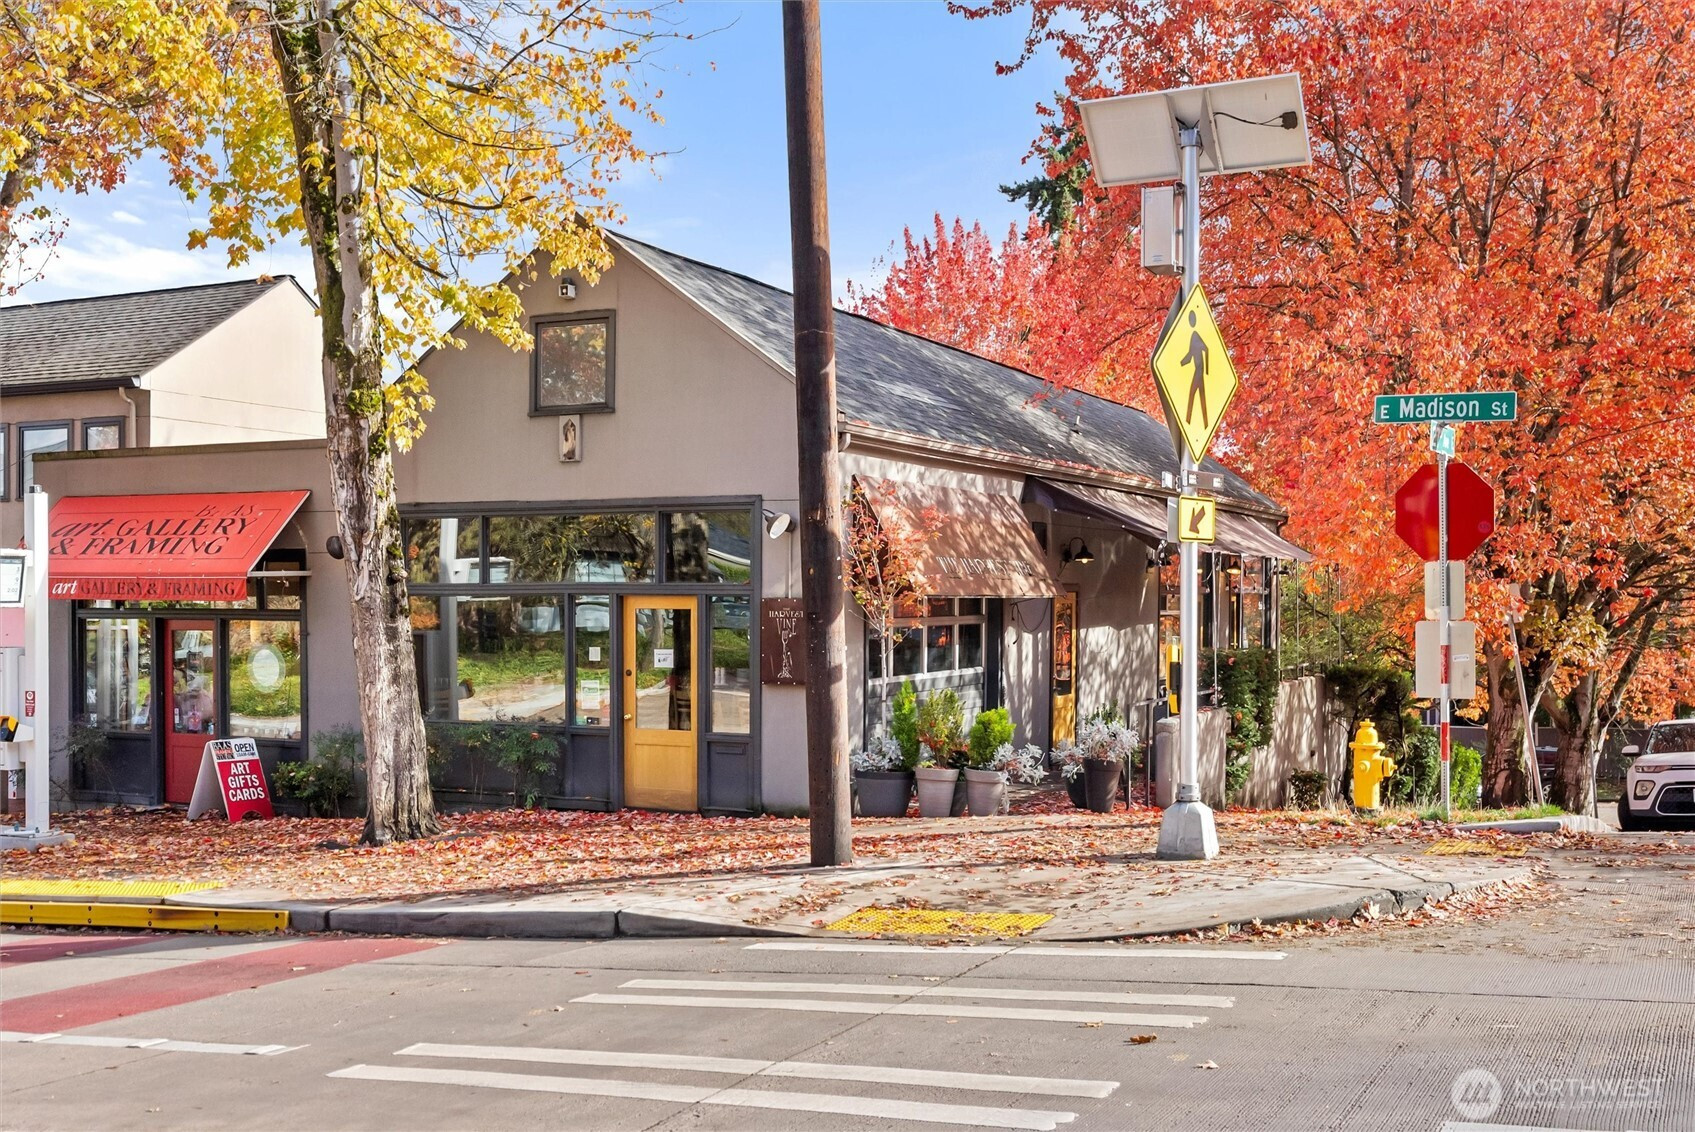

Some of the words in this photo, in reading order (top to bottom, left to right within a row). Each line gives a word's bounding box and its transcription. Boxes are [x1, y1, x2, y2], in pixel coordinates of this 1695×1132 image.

[1380, 405, 1390, 419] E
[1400, 397, 1480, 419] Madison
[1491, 401, 1508, 417] St
[116, 517, 258, 537] GALLERY
[49, 537, 75, 556] &
[78, 537, 229, 556] FRAMING
[52, 580, 78, 595] art
[80, 580, 144, 595] GALLERY
[146, 581, 158, 595] &
[163, 581, 236, 596] FRAMING
[768, 610, 804, 618] HARVEST
[776, 618, 797, 635] VINE
[234, 743, 255, 752] OPEN
[231, 762, 250, 775] ART
[228, 775, 260, 788] GIFTS
[228, 787, 265, 802] CARDS
